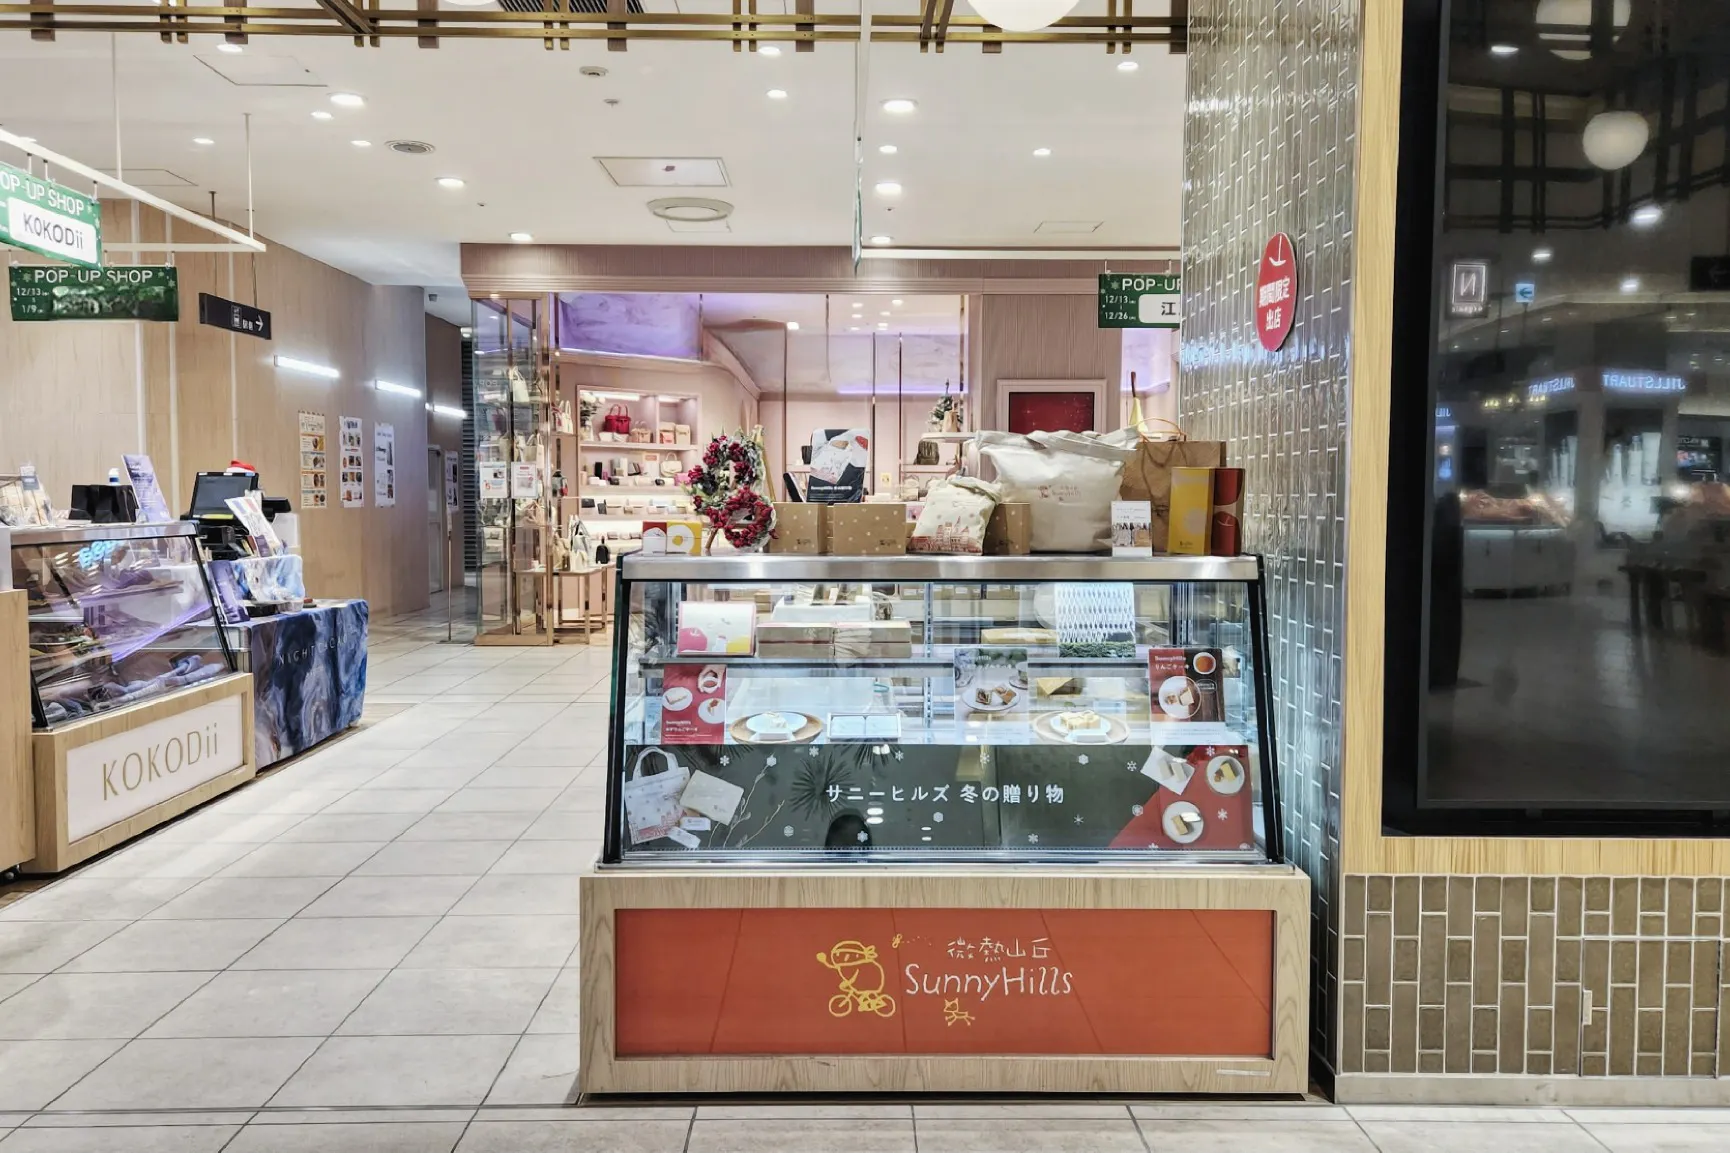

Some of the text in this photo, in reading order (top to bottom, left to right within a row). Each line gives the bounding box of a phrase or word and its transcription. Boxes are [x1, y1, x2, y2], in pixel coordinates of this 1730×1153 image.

[0, 171, 84, 216] OP-UP SHOP
[23, 212, 83, 250] KOKODii
[34, 269, 153, 283] POP-UP SHOP
[1258, 275, 1290, 308] 期間限定
[1161, 302, 1180, 316] 江
[1265, 306, 1282, 331] 出店
[278, 645, 315, 665] NIGHT
[102, 722, 218, 801] KOKODii
[825, 784, 1064, 803] サニーヒルズ 冬の贈り物
[947, 936, 1051, 962] 微熱山丘
[904, 963, 1073, 1002] SunnyHills
